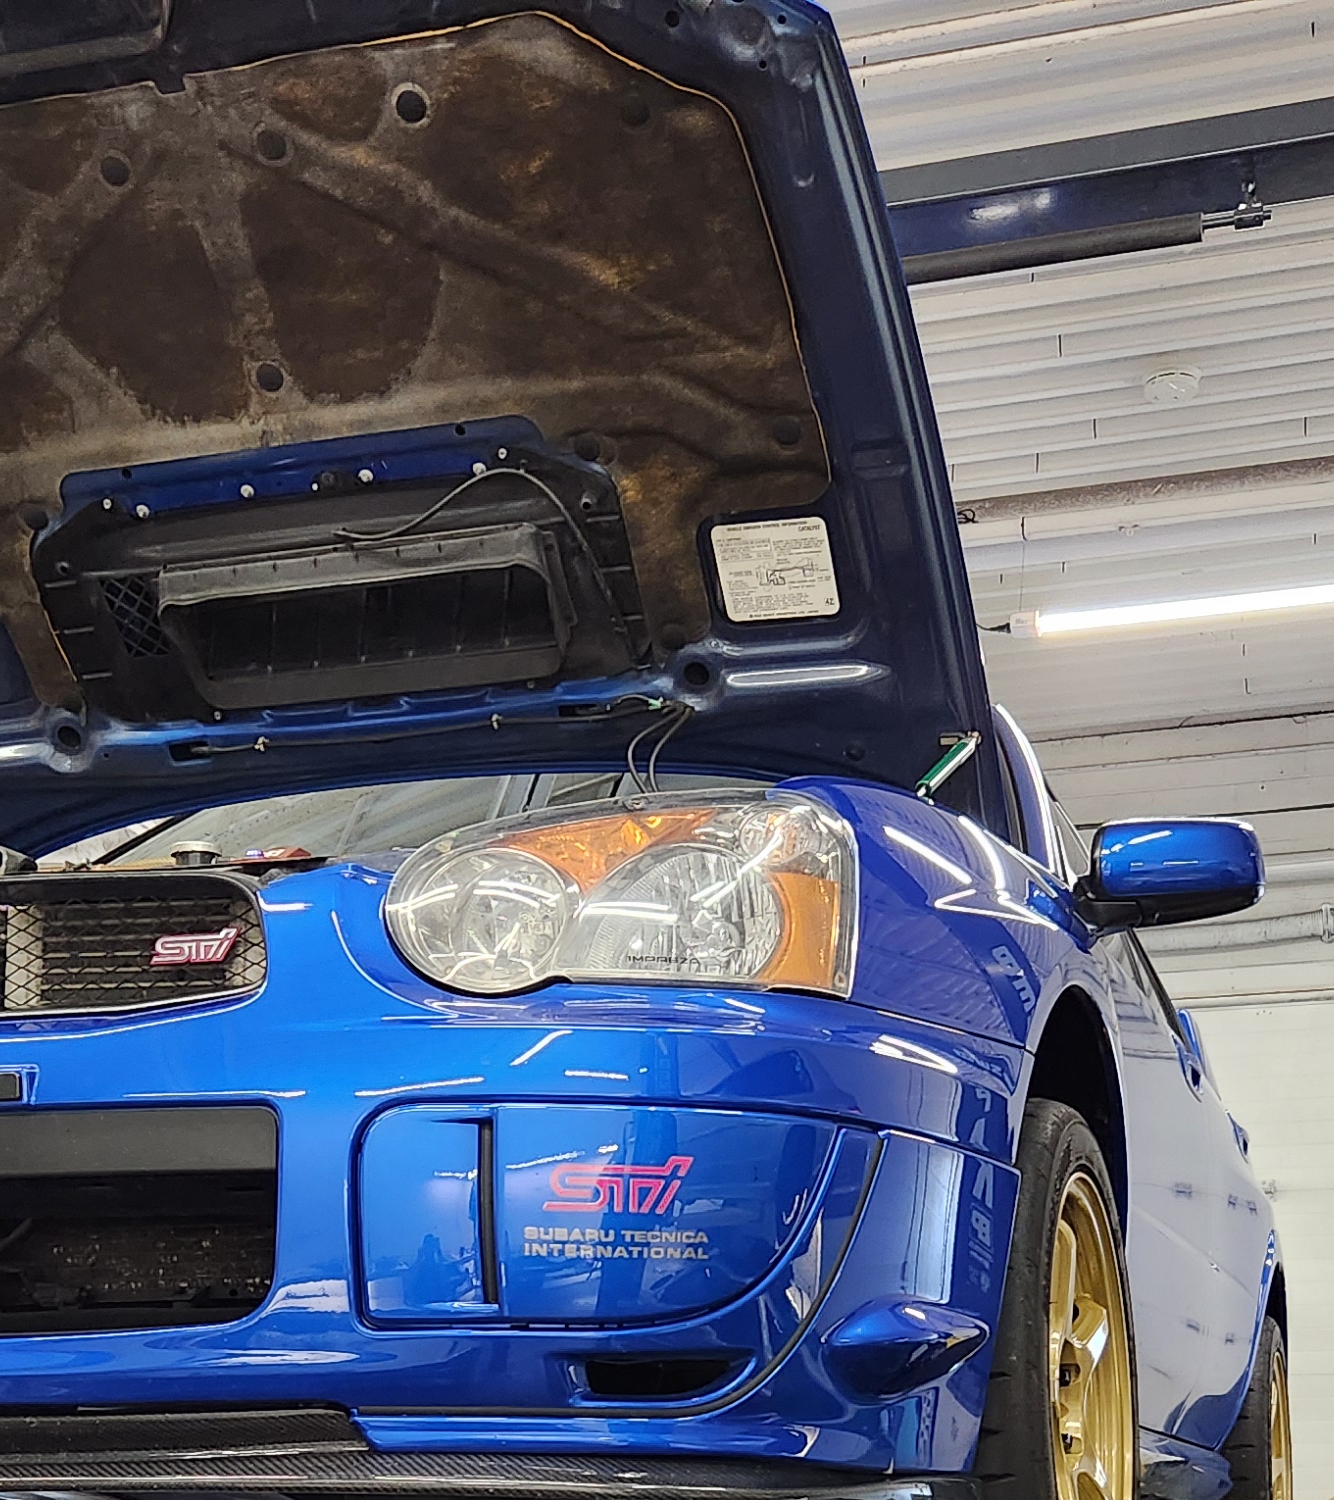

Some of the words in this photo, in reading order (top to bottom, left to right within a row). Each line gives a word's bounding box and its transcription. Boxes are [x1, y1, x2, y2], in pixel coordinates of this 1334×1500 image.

[524, 1227, 615, 1243] SUBARU
[621, 1229, 709, 1244] TECNICA
[524, 1243, 709, 1260] INTERNATIONAL
